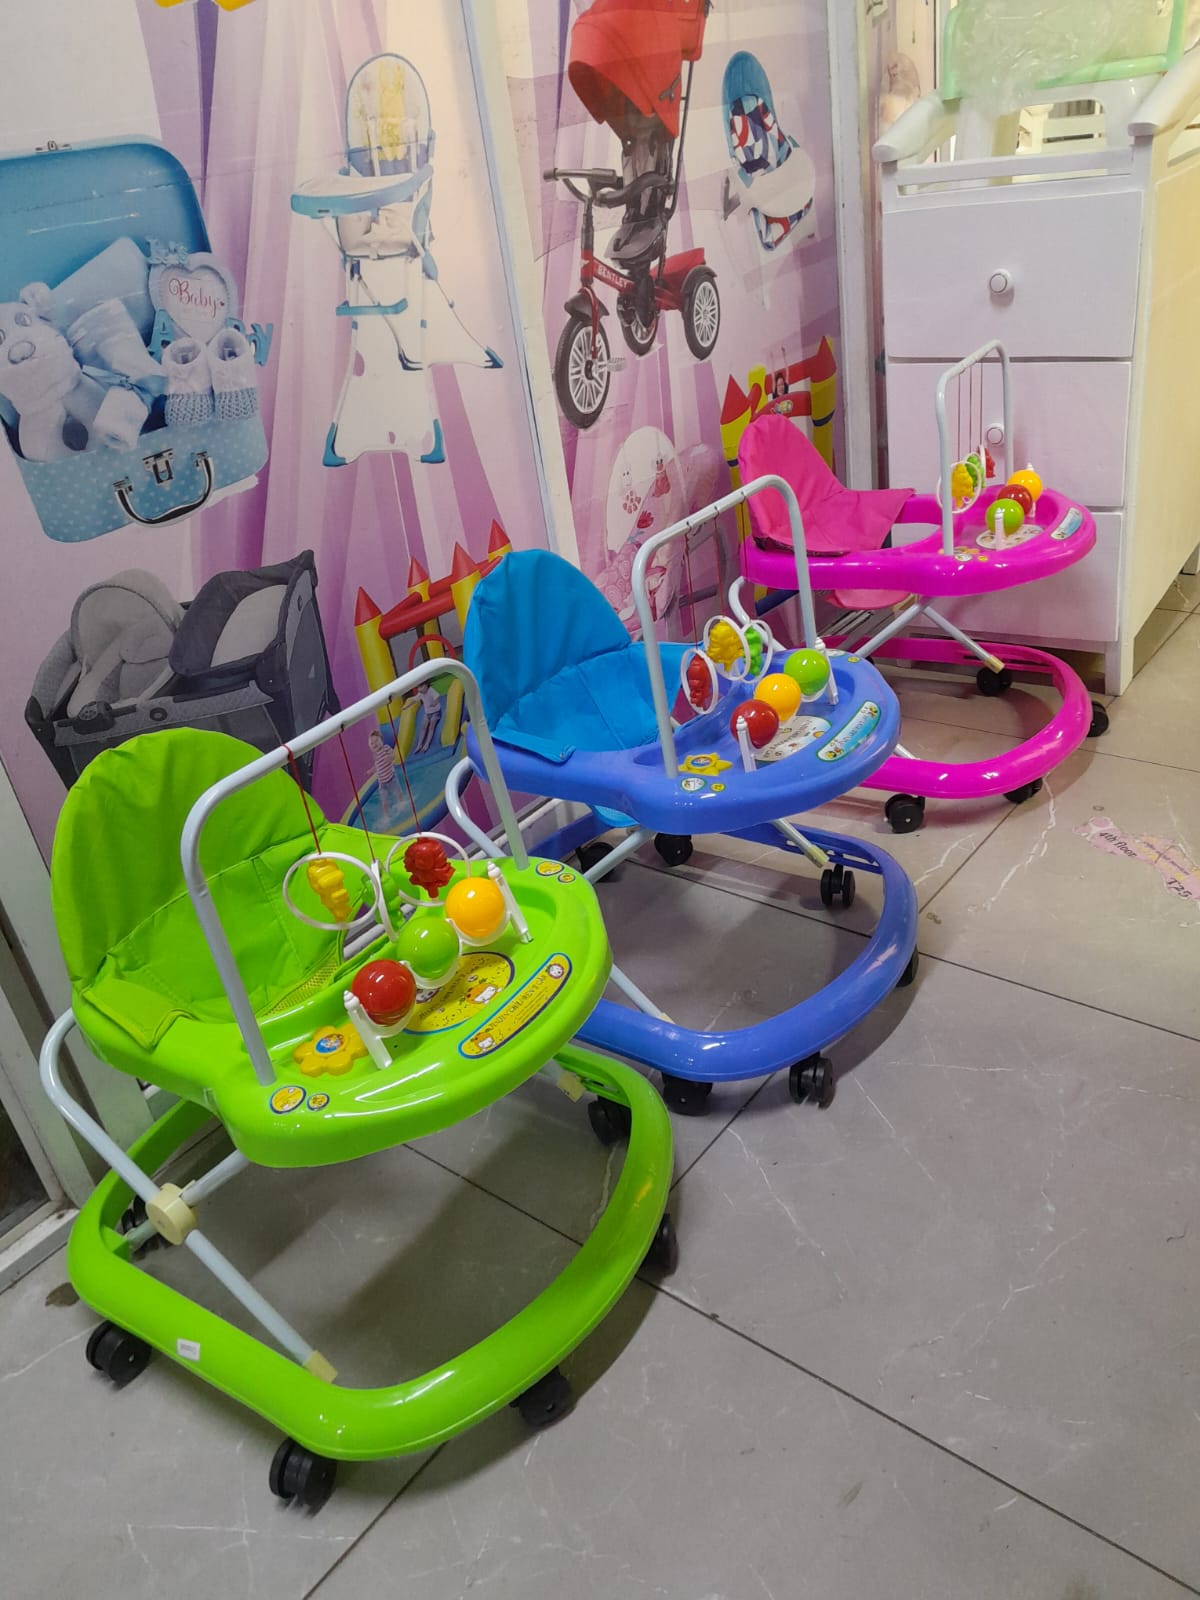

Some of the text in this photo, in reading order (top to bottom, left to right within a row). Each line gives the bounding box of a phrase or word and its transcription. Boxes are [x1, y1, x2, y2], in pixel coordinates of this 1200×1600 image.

[598, 264, 627, 289] BENTLEY
[169, 278, 217, 319] Baby
[1099, 832, 1138, 857] 4th floor
[1167, 877, 1193, 898] T25
